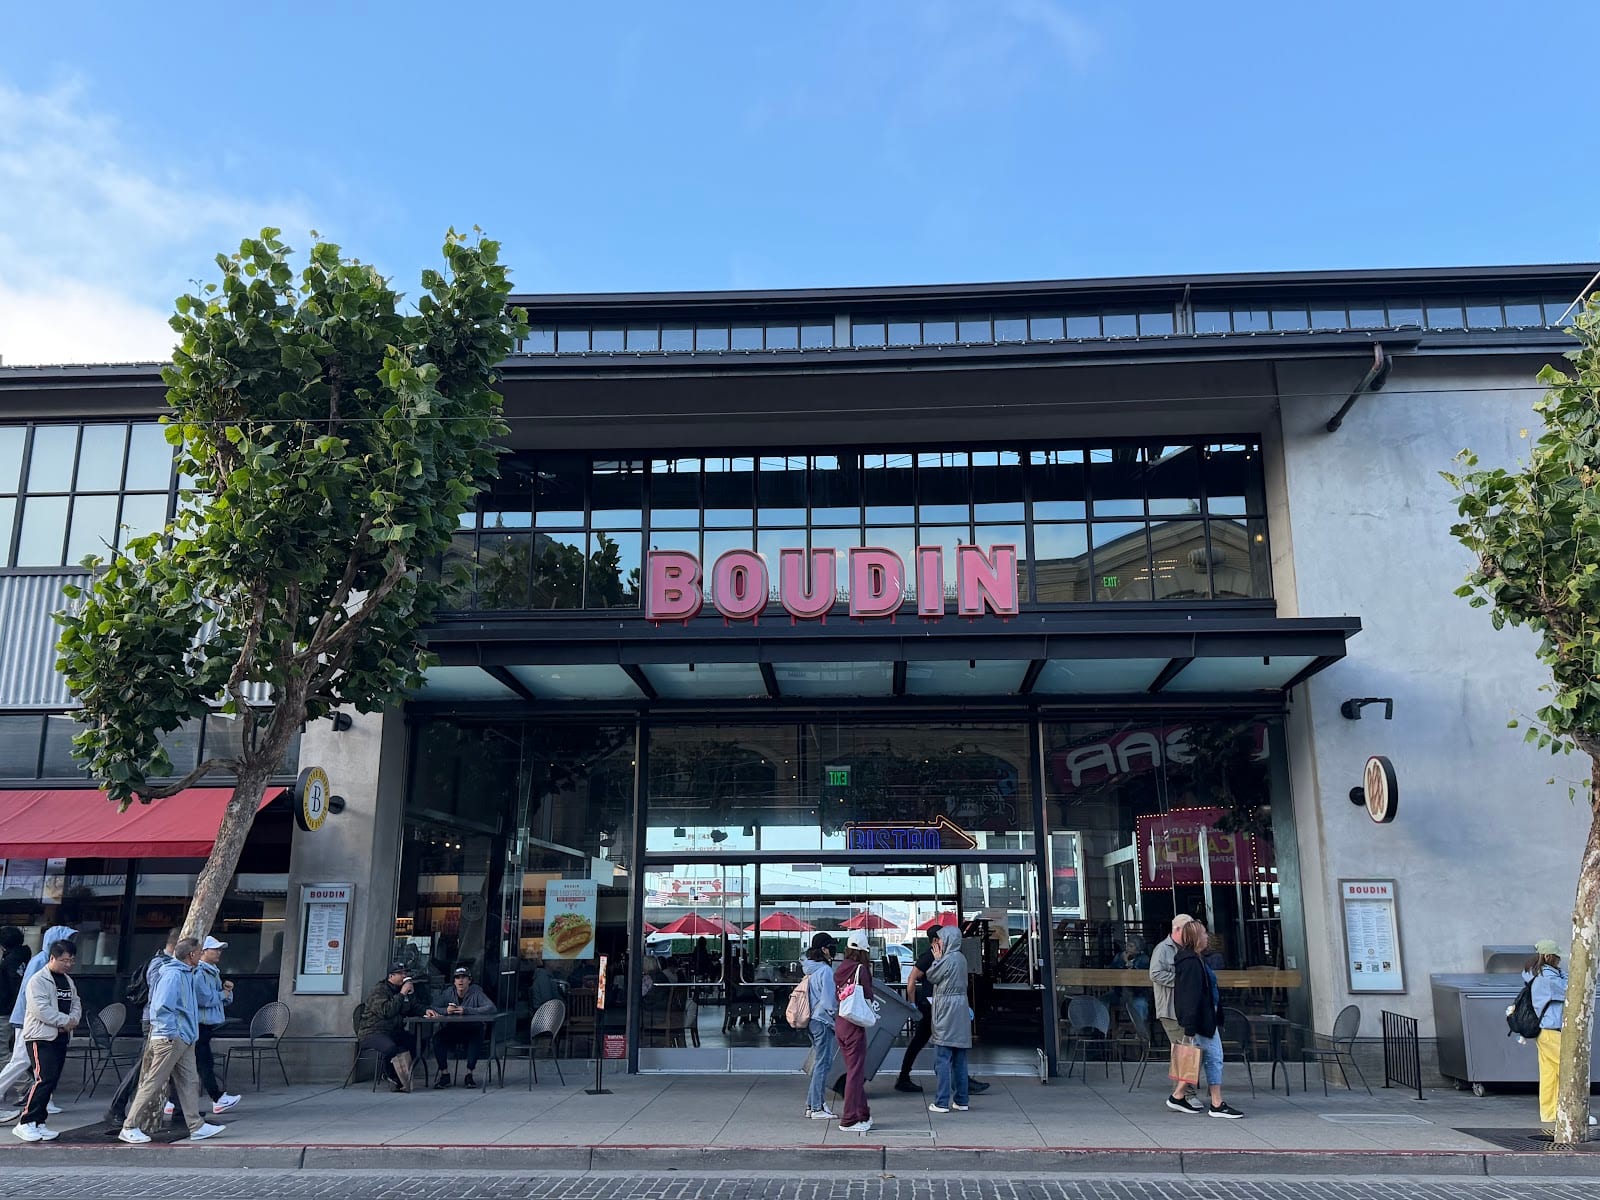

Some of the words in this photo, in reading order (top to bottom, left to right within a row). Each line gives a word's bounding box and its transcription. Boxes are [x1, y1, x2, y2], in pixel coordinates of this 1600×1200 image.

[645, 544, 1019, 621] BOUDIN
[1103, 576, 1117, 587] EXIT
[311, 785, 321, 813] B
[849, 829, 941, 850] BISTRO
[310, 891, 345, 899] BOUDIN
[1349, 886, 1387, 894] BOUDIN
